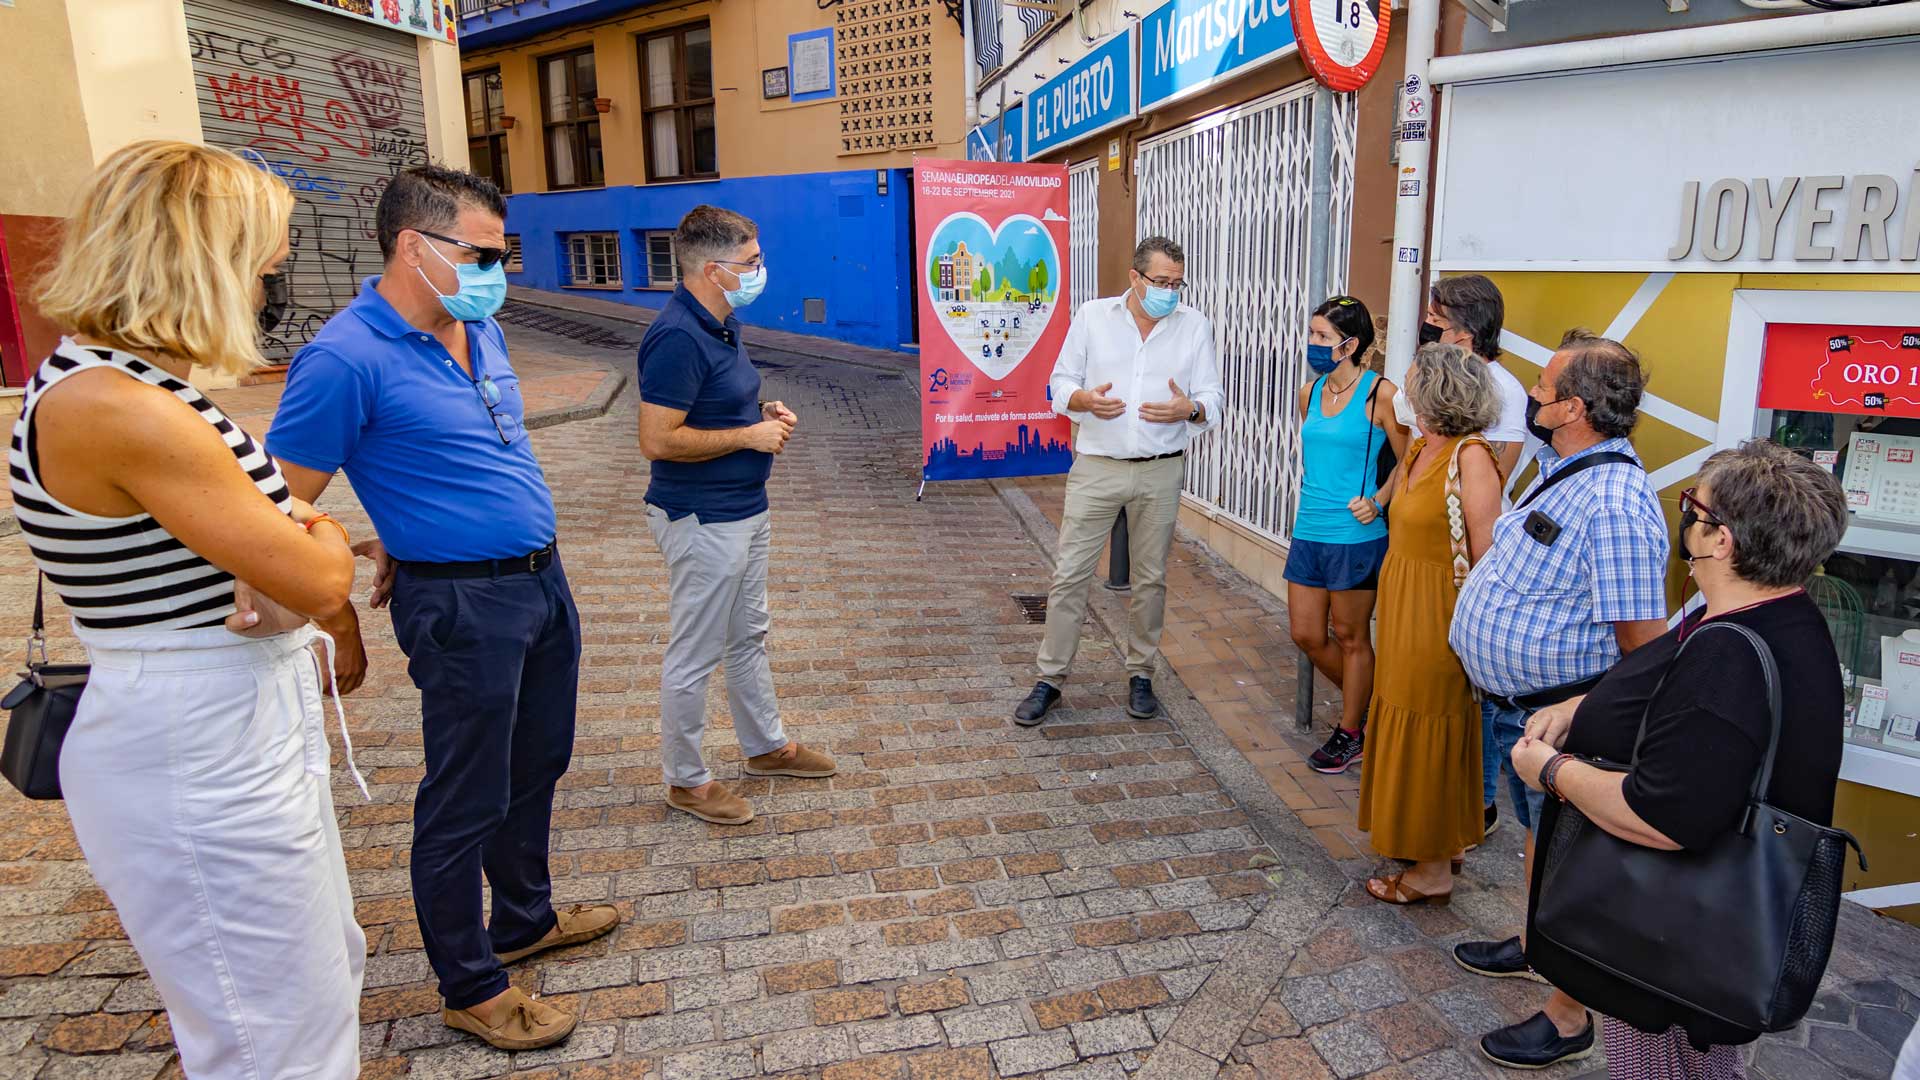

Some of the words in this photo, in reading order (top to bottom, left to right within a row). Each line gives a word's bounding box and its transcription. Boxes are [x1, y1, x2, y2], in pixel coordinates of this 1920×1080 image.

[1037, 94, 1050, 141] EL
[1053, 54, 1114, 134] PUERTO
[1402, 131, 1425, 140] KUSH
[942, 187, 951, 196] DE
[953, 187, 999, 198] SEPTIEMBRE
[999, 189, 1016, 199] 2021
[1829, 338, 1848, 350] 50%
[1843, 363, 1900, 385] ORO
[1864, 395, 1883, 406] 50%
[935, 413, 947, 423] Por
[955, 412, 974, 424] salud,
[1001, 411, 1009, 421] de
[1009, 410, 1027, 421] forma
